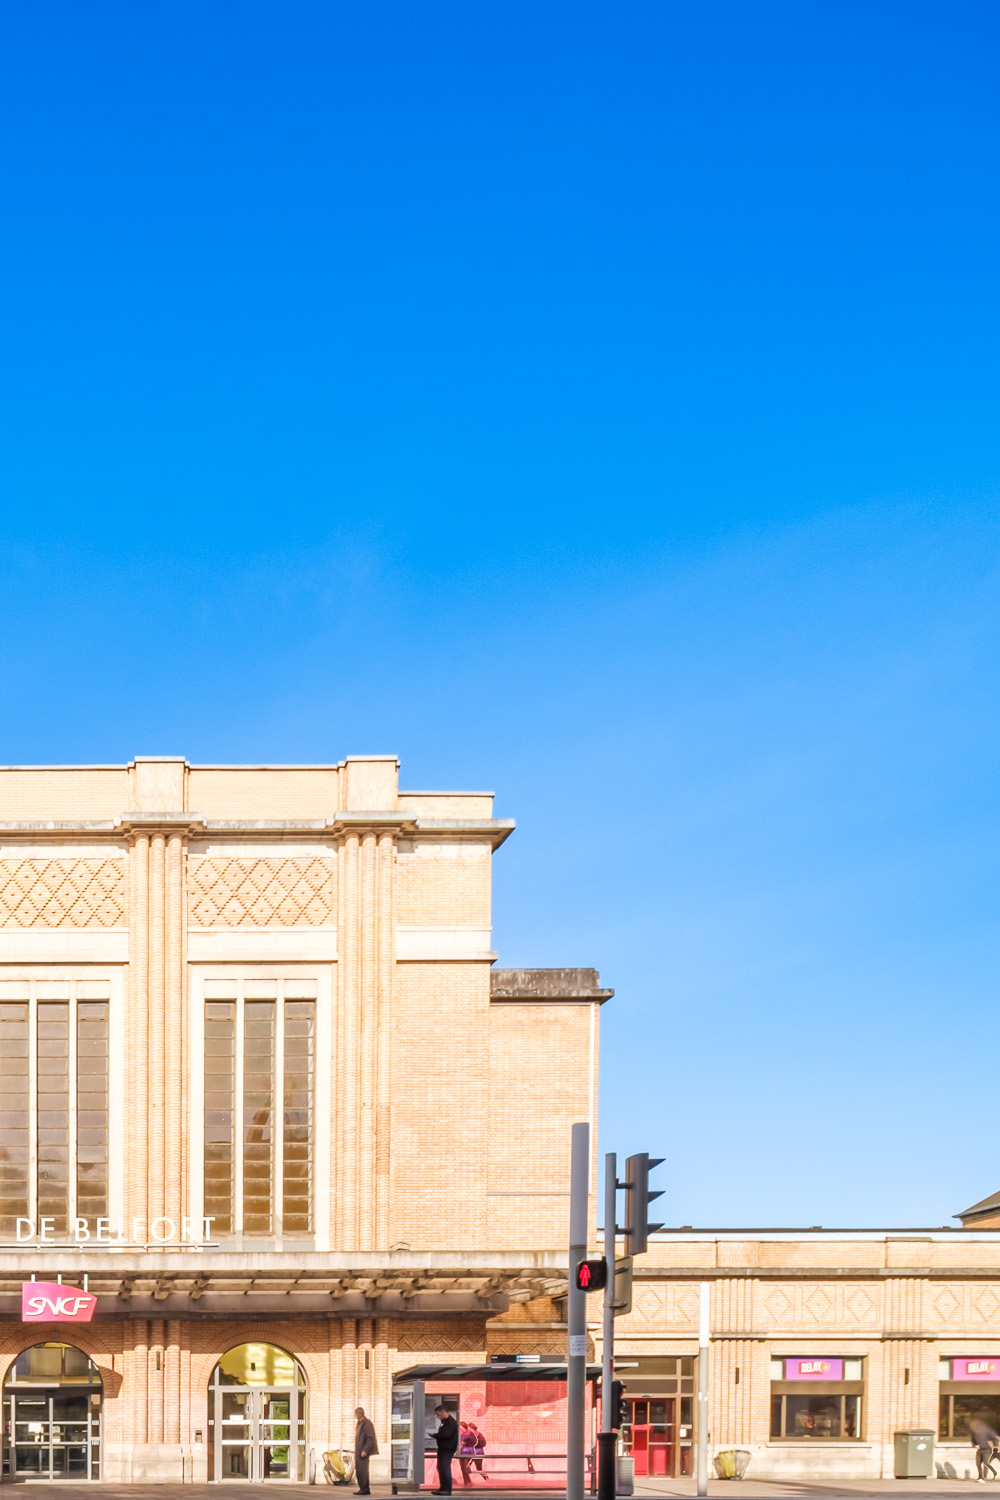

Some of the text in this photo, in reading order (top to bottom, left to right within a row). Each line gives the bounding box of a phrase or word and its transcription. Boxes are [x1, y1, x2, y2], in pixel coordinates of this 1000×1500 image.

[16, 1217, 56, 1243] DE
[75, 1216, 216, 1243] BELFORT
[25, 1296, 92, 1316] SNCF
[801, 1361, 823, 1373] RELAY
[967, 1361, 989, 1373] RELAY
